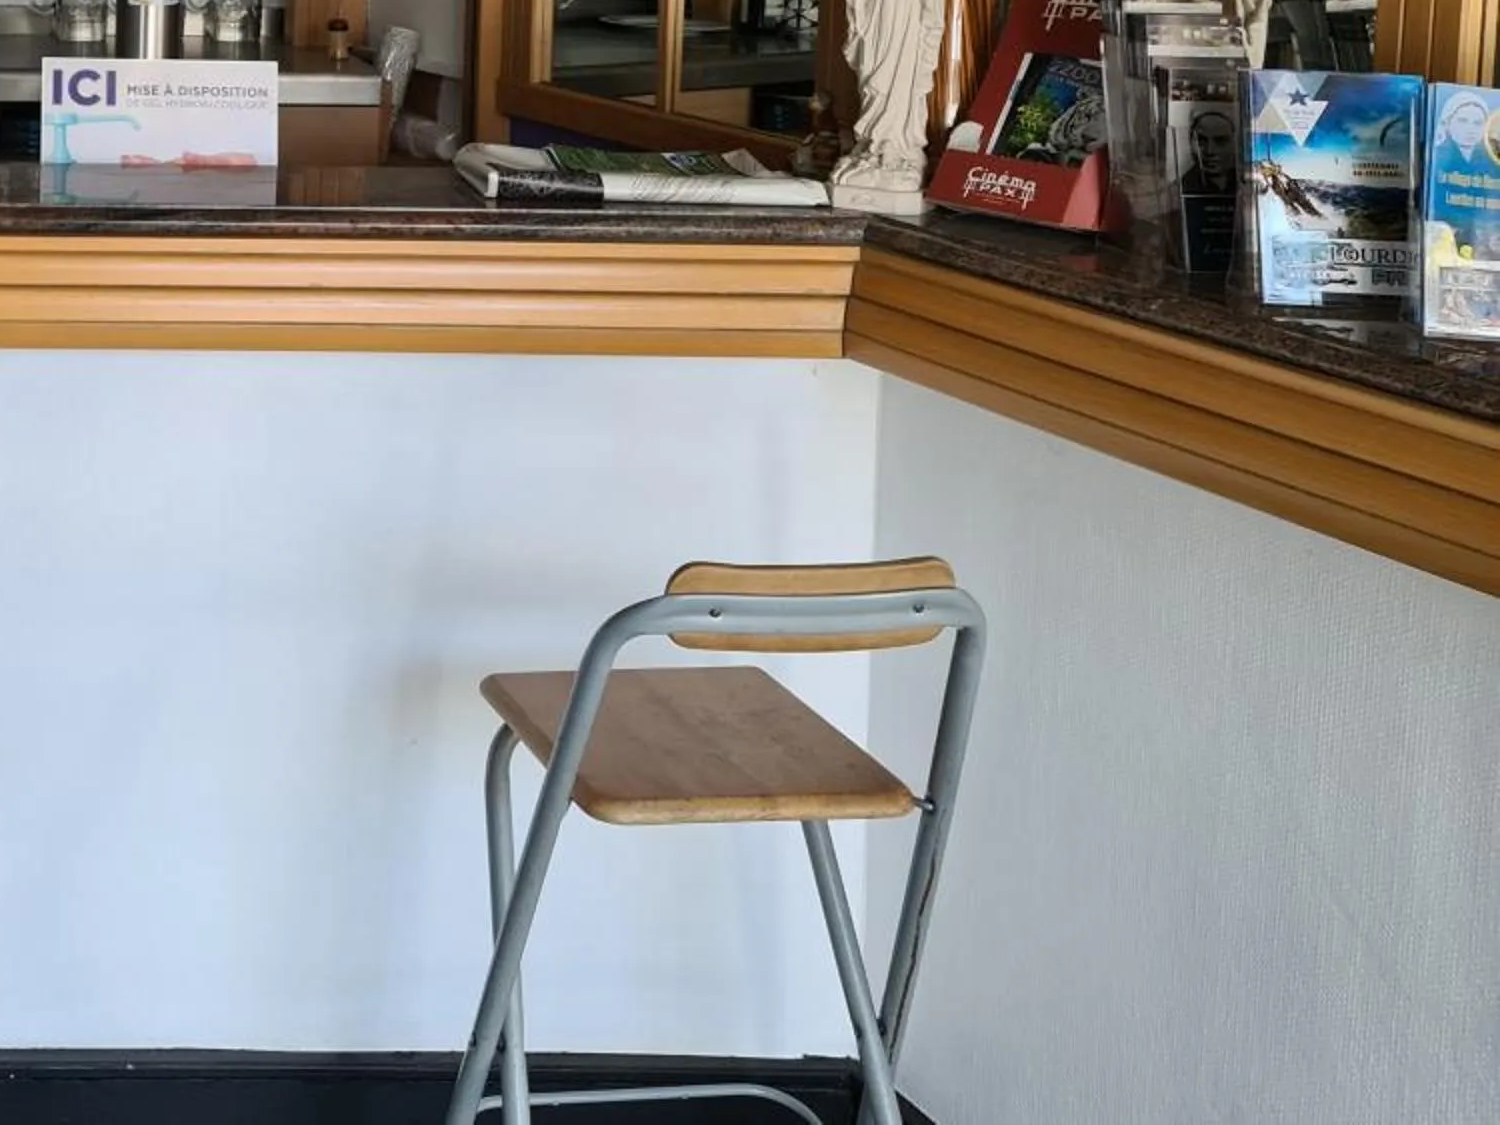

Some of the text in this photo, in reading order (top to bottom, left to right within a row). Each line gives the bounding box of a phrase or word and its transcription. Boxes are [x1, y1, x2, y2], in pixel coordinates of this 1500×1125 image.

[52, 69, 117, 106] ICI
[127, 85, 159, 96] MISE
[178, 86, 268, 98] DISPOSITION
